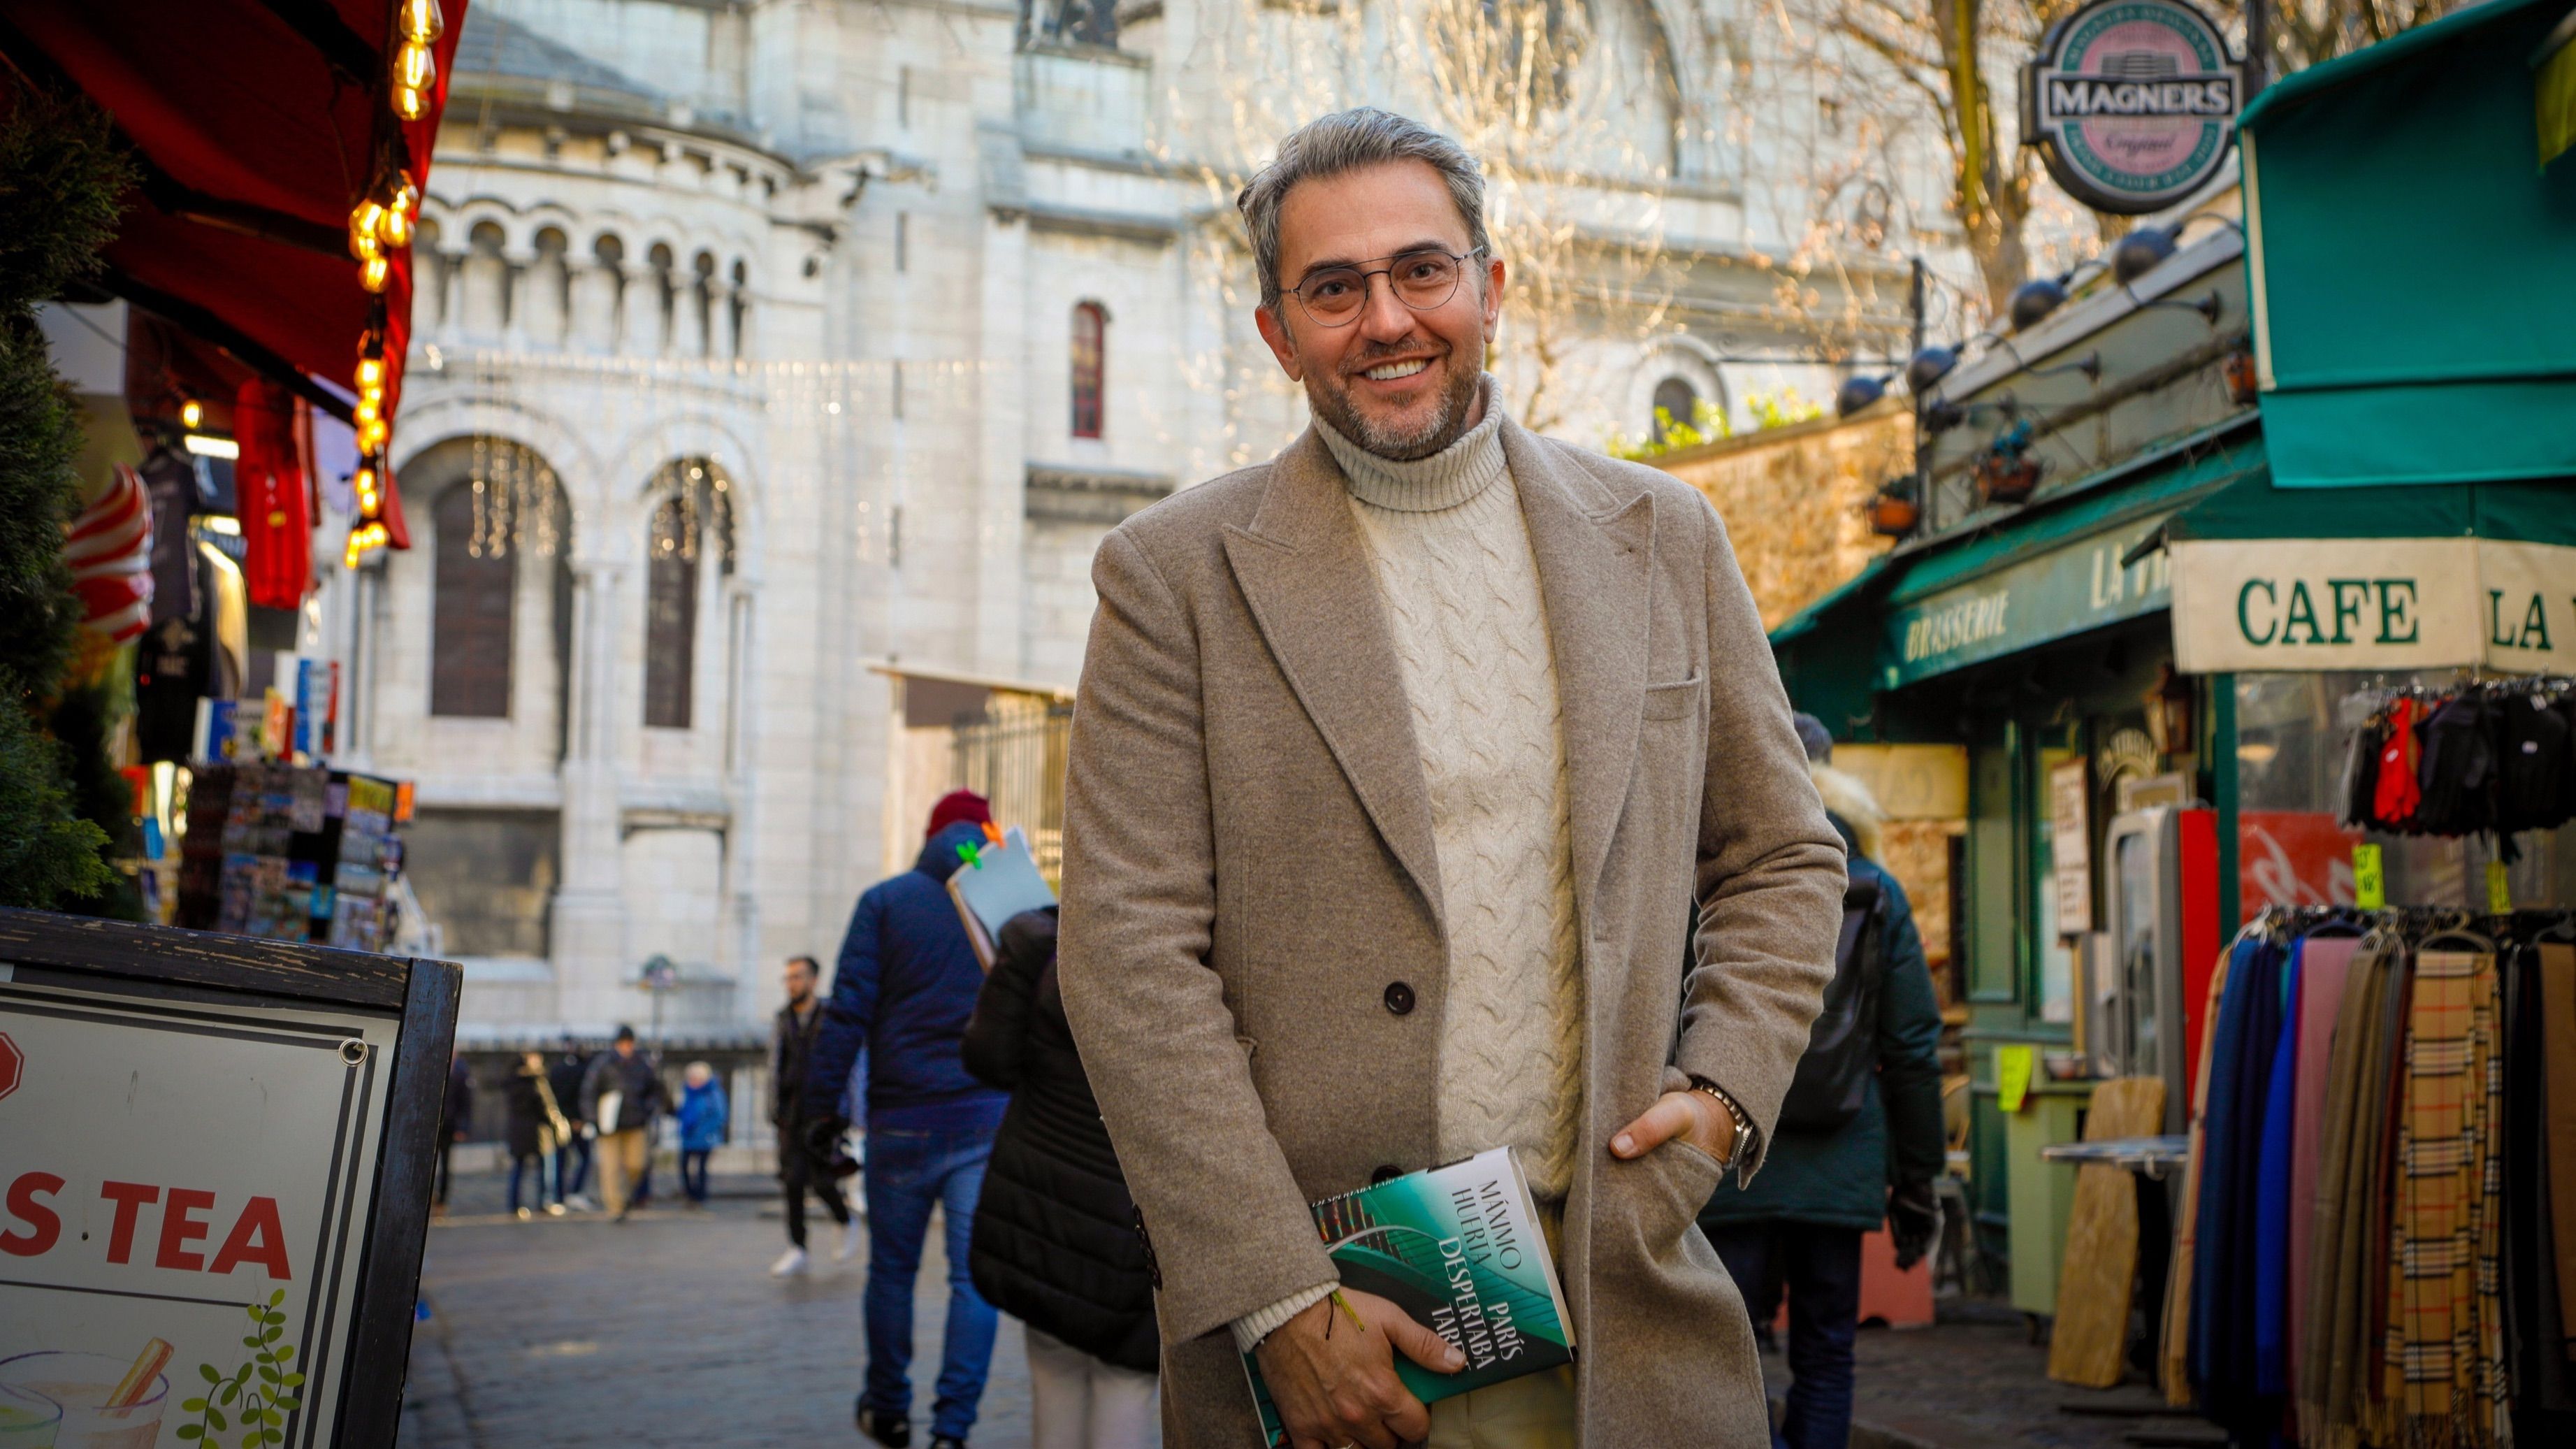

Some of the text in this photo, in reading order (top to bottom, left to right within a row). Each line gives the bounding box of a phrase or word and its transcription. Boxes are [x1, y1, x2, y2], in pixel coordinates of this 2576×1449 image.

[2052, 81, 2231, 114] MAGNERS
[1904, 590, 2009, 663] BRASSERIE
[2238, 578, 2419, 647] CAFE
[2489, 589, 2552, 651] LA
[100, 1181, 292, 1281] TEA
[1452, 1188, 1492, 1265] HUERTA
[1477, 1180, 1522, 1270] MÁXIMO
[1438, 1237, 1496, 1370] DESPERTABA
[1487, 1302, 1526, 1361] PARÍS
